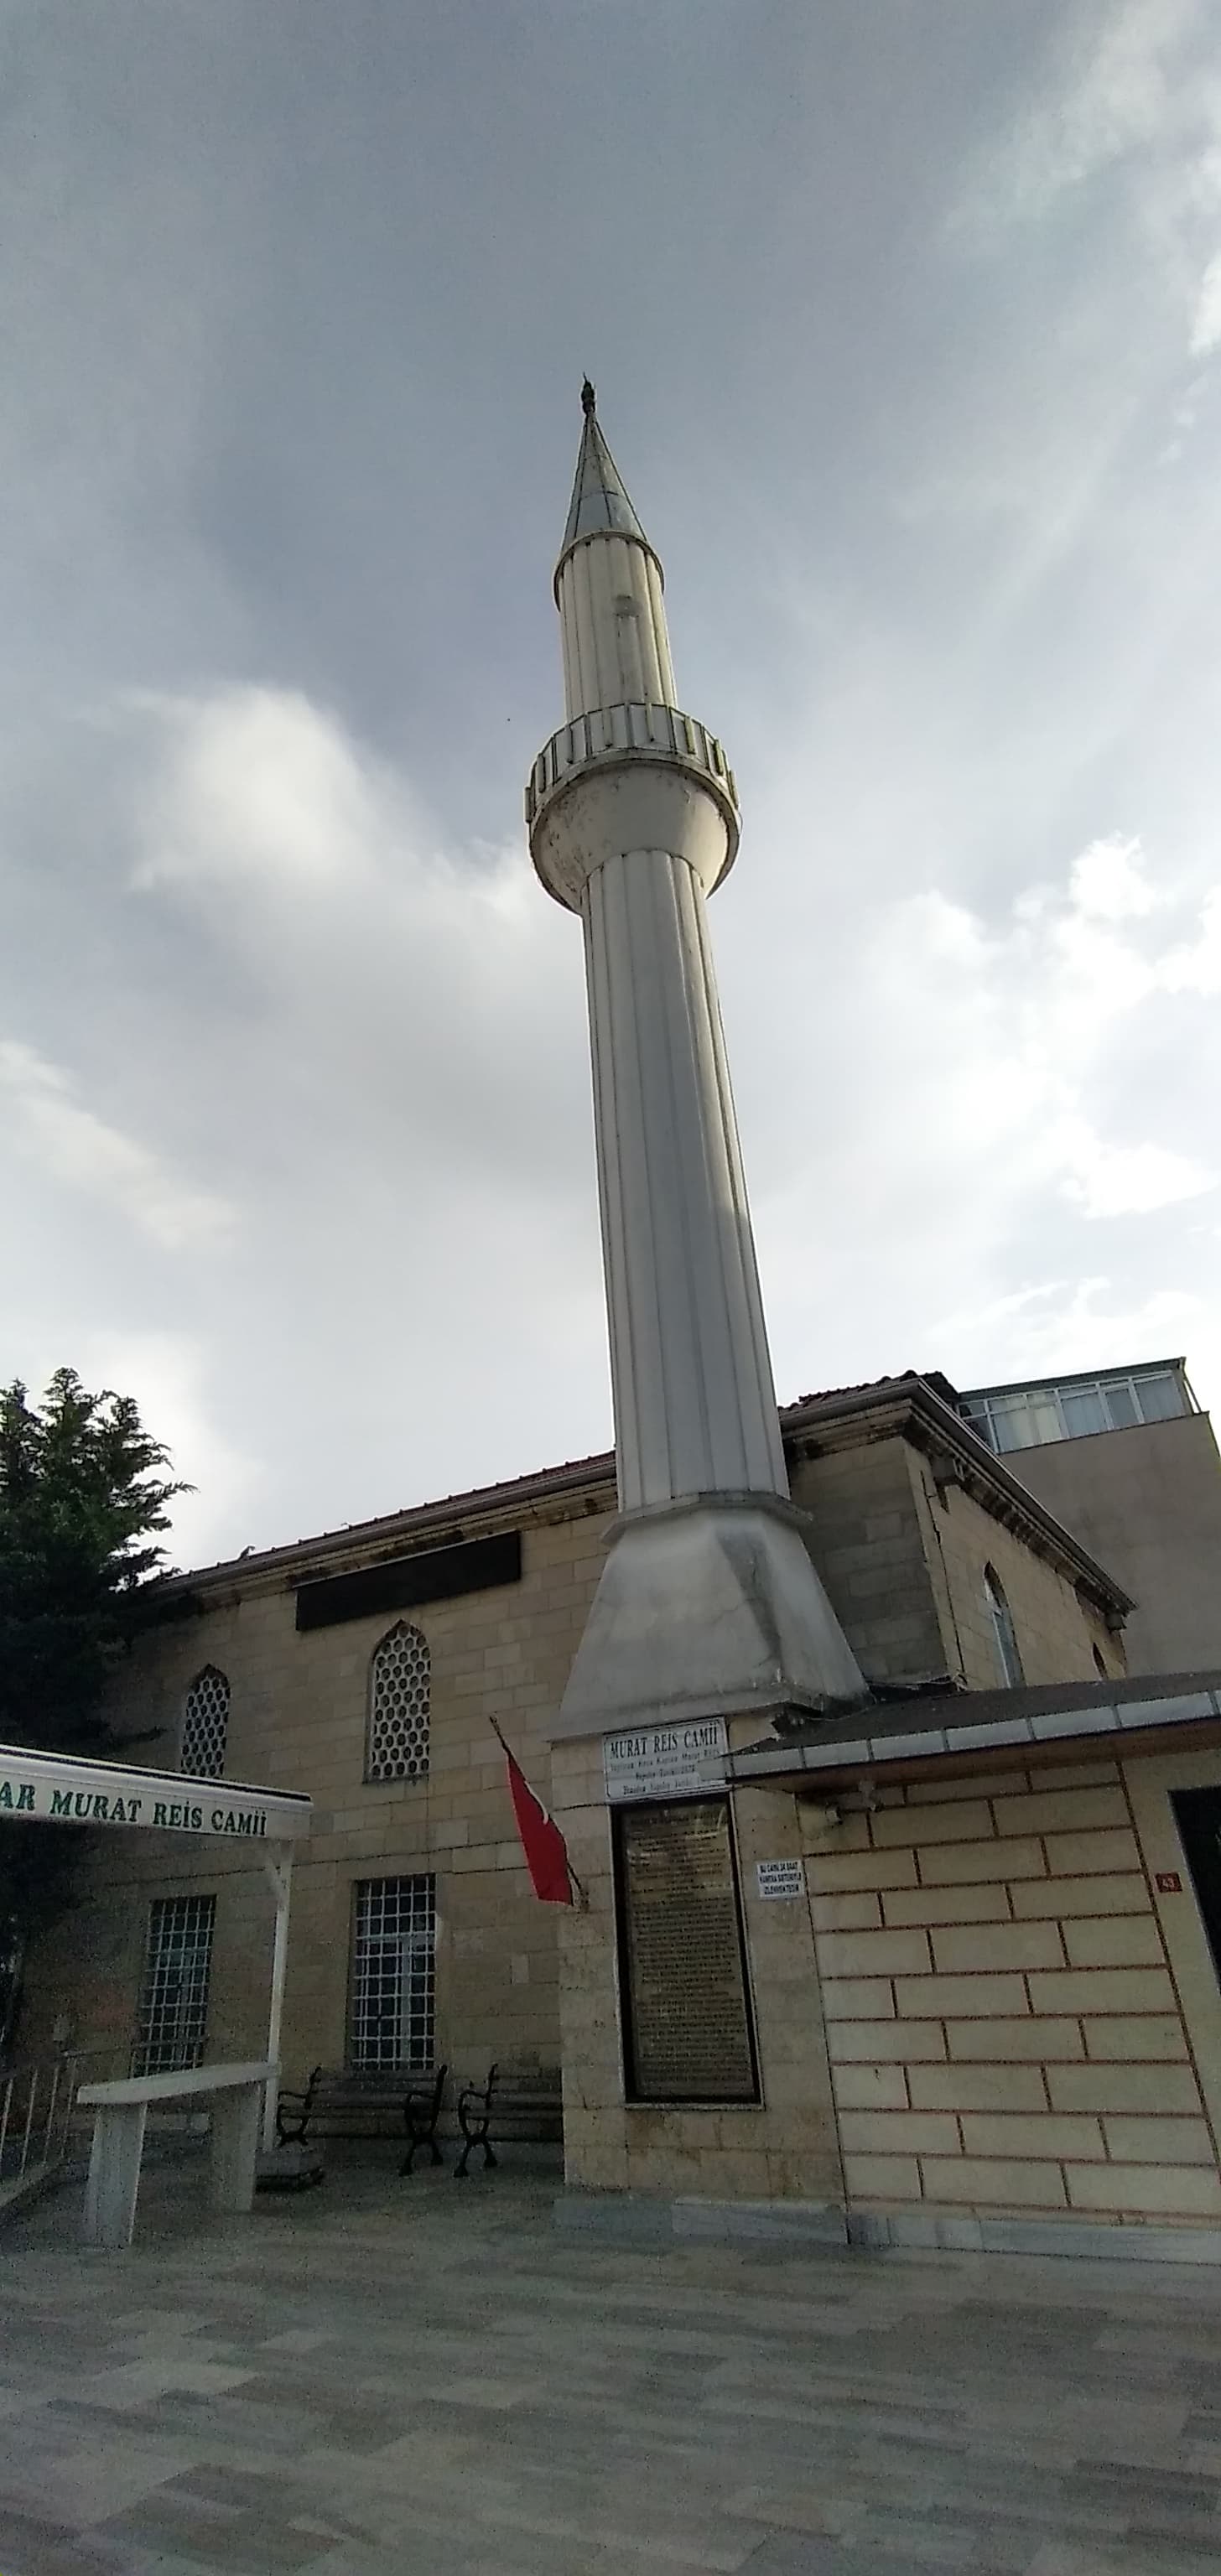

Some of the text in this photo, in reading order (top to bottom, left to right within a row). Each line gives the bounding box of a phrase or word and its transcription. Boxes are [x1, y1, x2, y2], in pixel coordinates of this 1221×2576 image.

[610, 1737, 647, 1759] MURAT
[683, 1722, 718, 1749] CAMİİ
[49, 1789, 142, 1823] MURAT
[153, 1800, 204, 1829] REİS
[210, 1810, 268, 1836] CAMİİ
